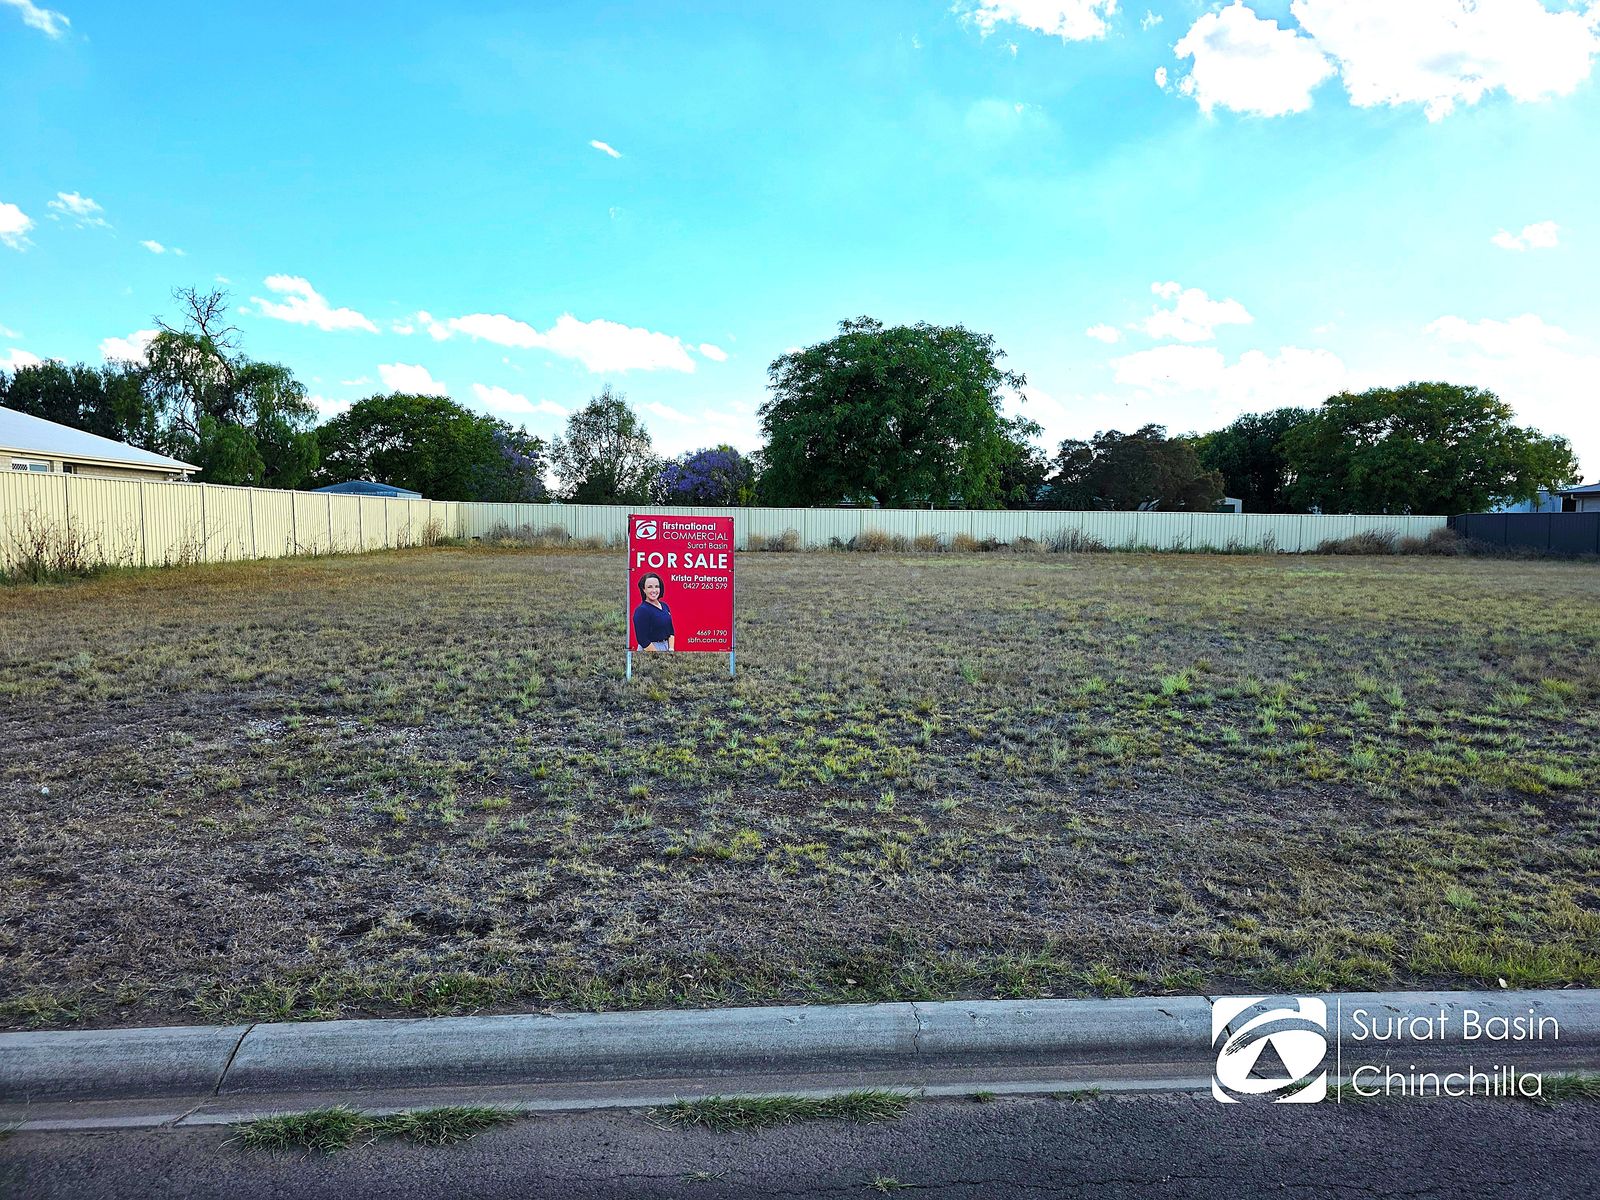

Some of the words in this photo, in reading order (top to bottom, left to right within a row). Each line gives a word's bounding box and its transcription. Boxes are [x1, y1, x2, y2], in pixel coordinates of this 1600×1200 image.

[663, 522, 716, 530] firstnational
[663, 532, 728, 540] COMMERCIAL
[636, 552, 677, 568] FOR
[684, 553, 728, 569] SALE
